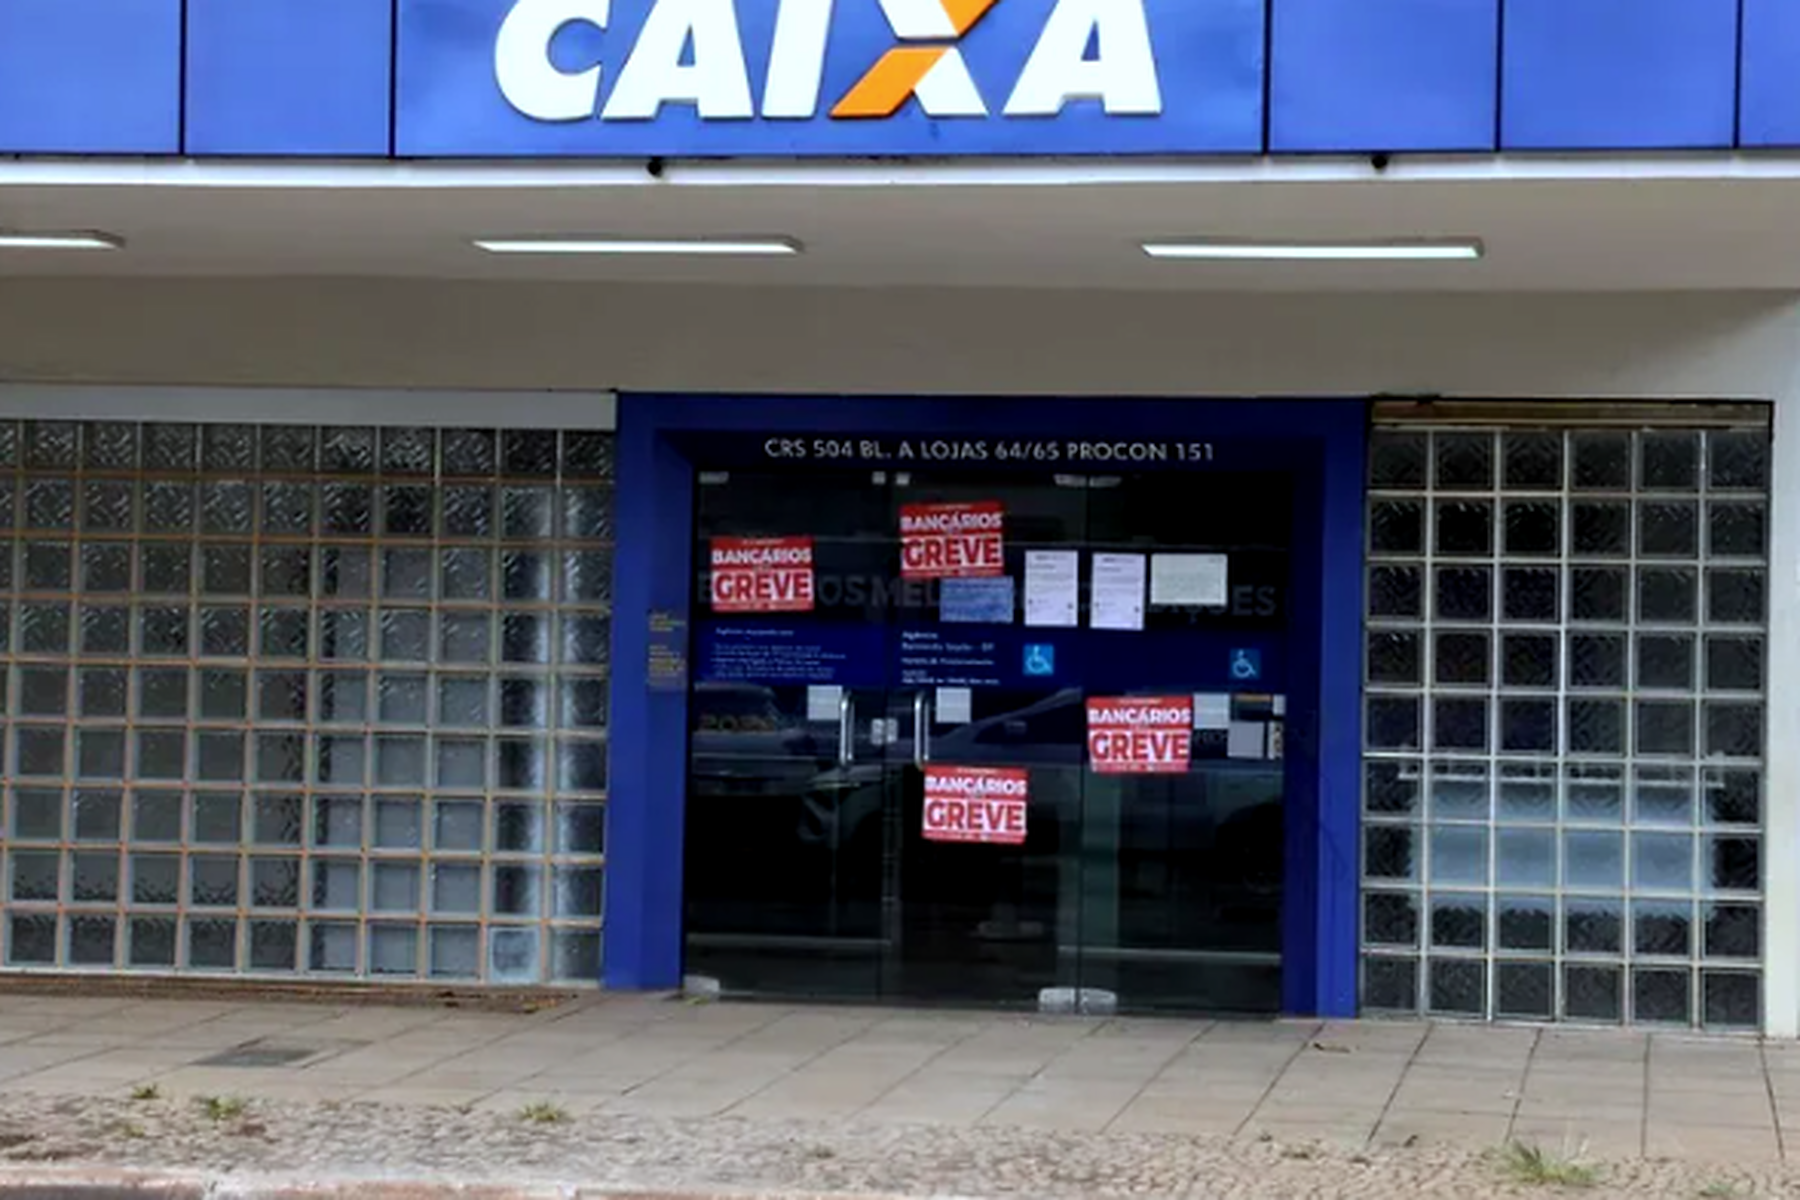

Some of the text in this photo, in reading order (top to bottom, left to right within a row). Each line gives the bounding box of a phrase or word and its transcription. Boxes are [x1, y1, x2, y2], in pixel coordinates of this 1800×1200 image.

[494, 0, 1163, 121] CAIXA
[764, 438, 1214, 461] CRS 504 BL. A LOJAS 64/65 PROCON 151
[900, 511, 1003, 532] BANCÁRIOS
[712, 547, 812, 564] BANCÁRIOS
[904, 538, 999, 567] GREVE
[714, 572, 810, 601] GREVE
[1088, 706, 1191, 724] BANCÁRIOS
[1090, 732, 1189, 761] GREVE
[925, 775, 1027, 796] BANCÁRIOS
[926, 801, 1024, 830] GREVE
